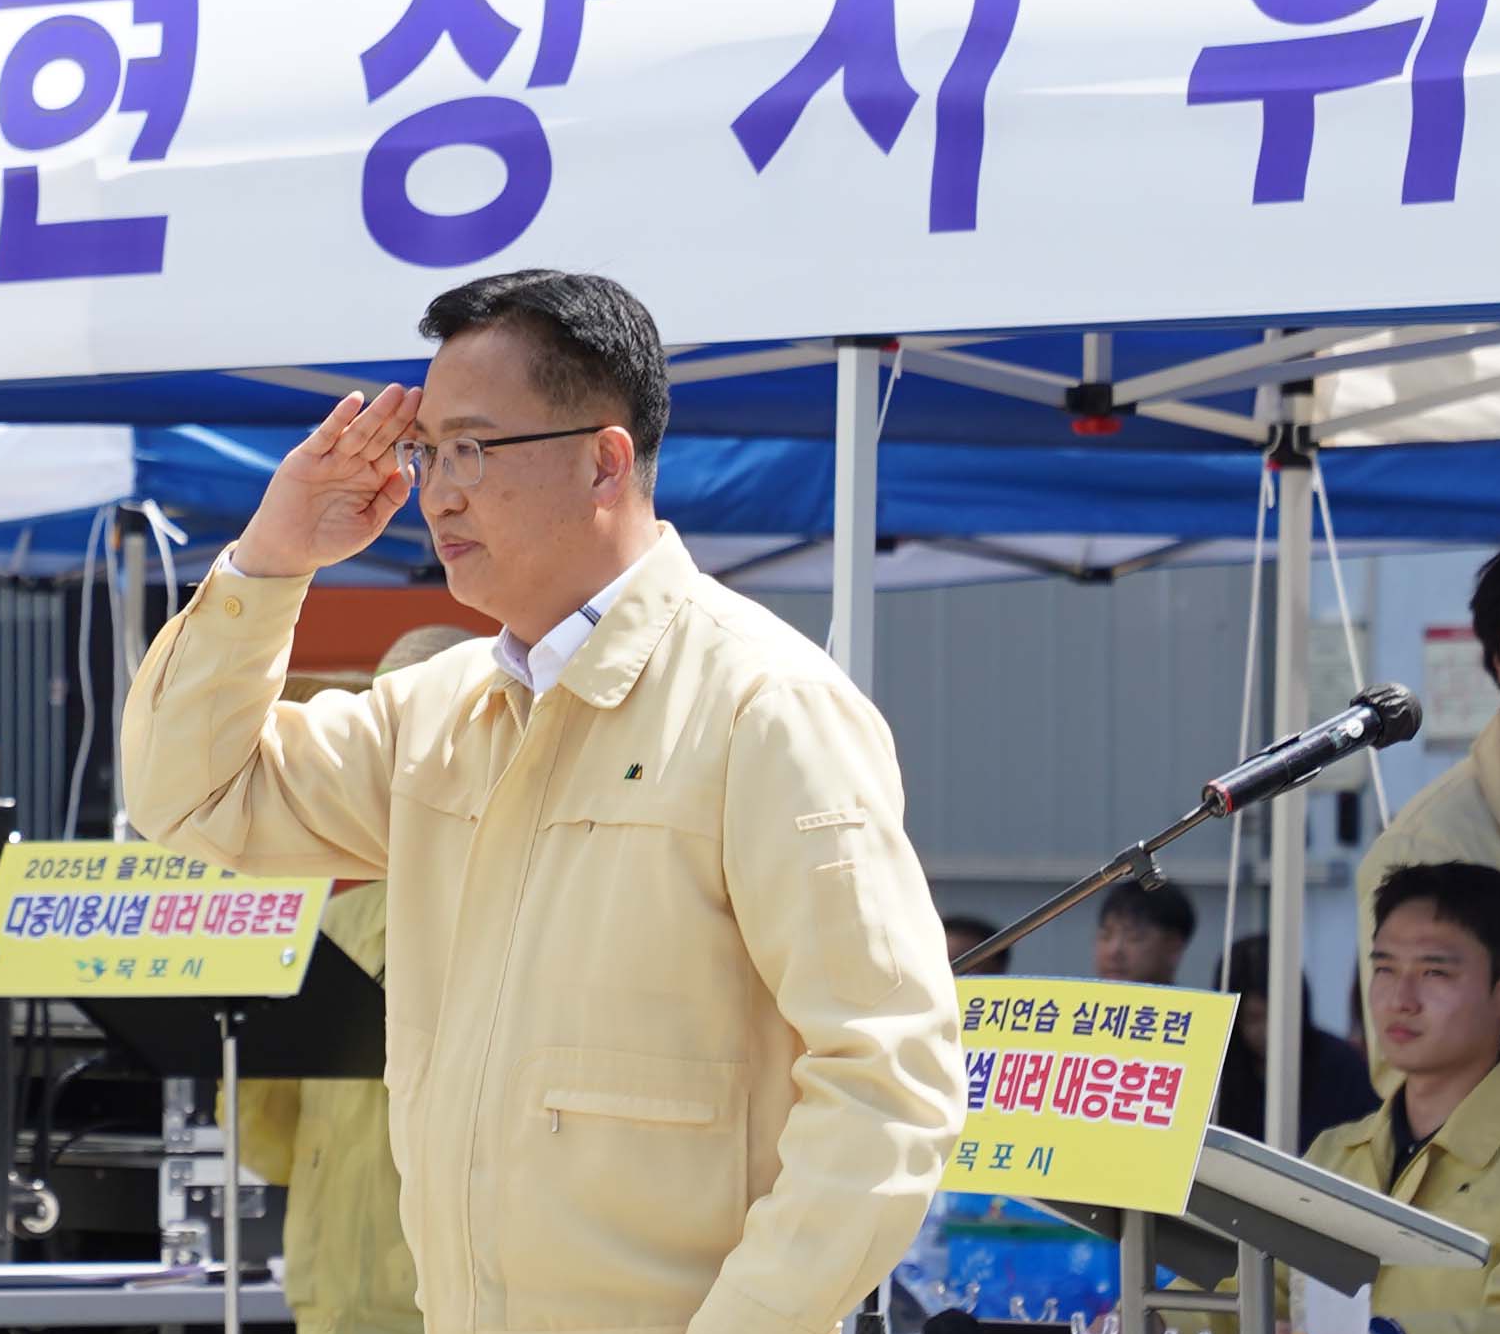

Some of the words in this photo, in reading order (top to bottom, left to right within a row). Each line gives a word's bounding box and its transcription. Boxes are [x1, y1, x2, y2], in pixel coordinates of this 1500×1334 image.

[25, 856, 107, 880] 2025년
[4, 893, 150, 939] 다중이용시설
[150, 894, 202, 935] 테러
[203, 892, 305, 935] 대응훈련
[962, 997, 1060, 1034] 을지연습
[1072, 1001, 1193, 1046] 실제훈련
[994, 1053, 1054, 1112] 테러
[1053, 1056, 1184, 1126] 대응훈련
